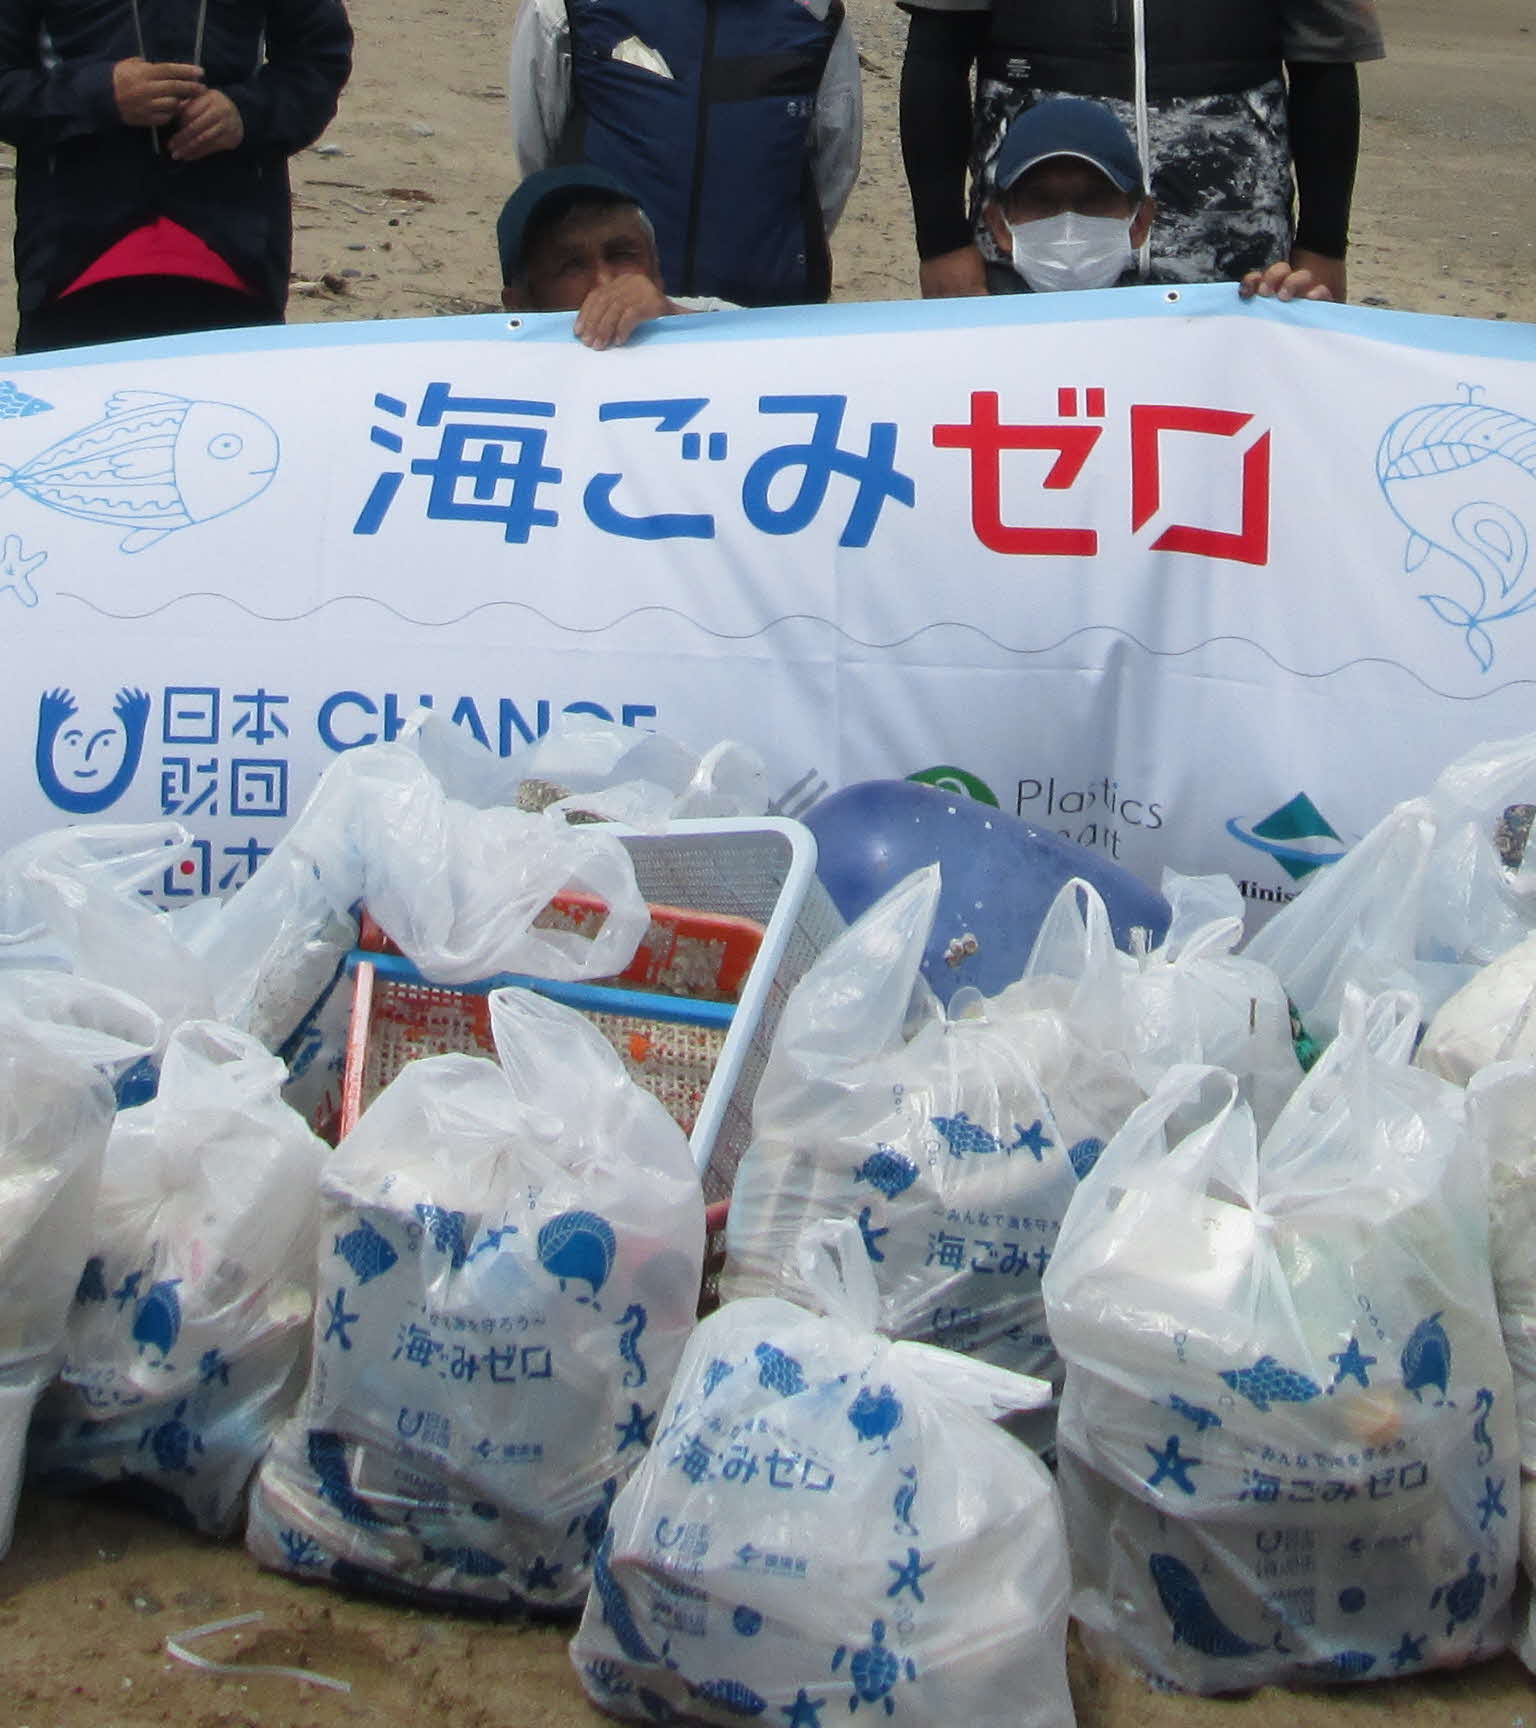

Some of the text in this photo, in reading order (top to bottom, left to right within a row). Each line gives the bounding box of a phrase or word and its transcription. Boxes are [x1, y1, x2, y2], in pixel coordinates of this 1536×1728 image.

[352, 381, 1271, 566] 海ごみゼロ
[161, 686, 290, 746] 日本
[160, 757, 289, 817] 財団
[667, 1432, 835, 1492] 海みゼロ
